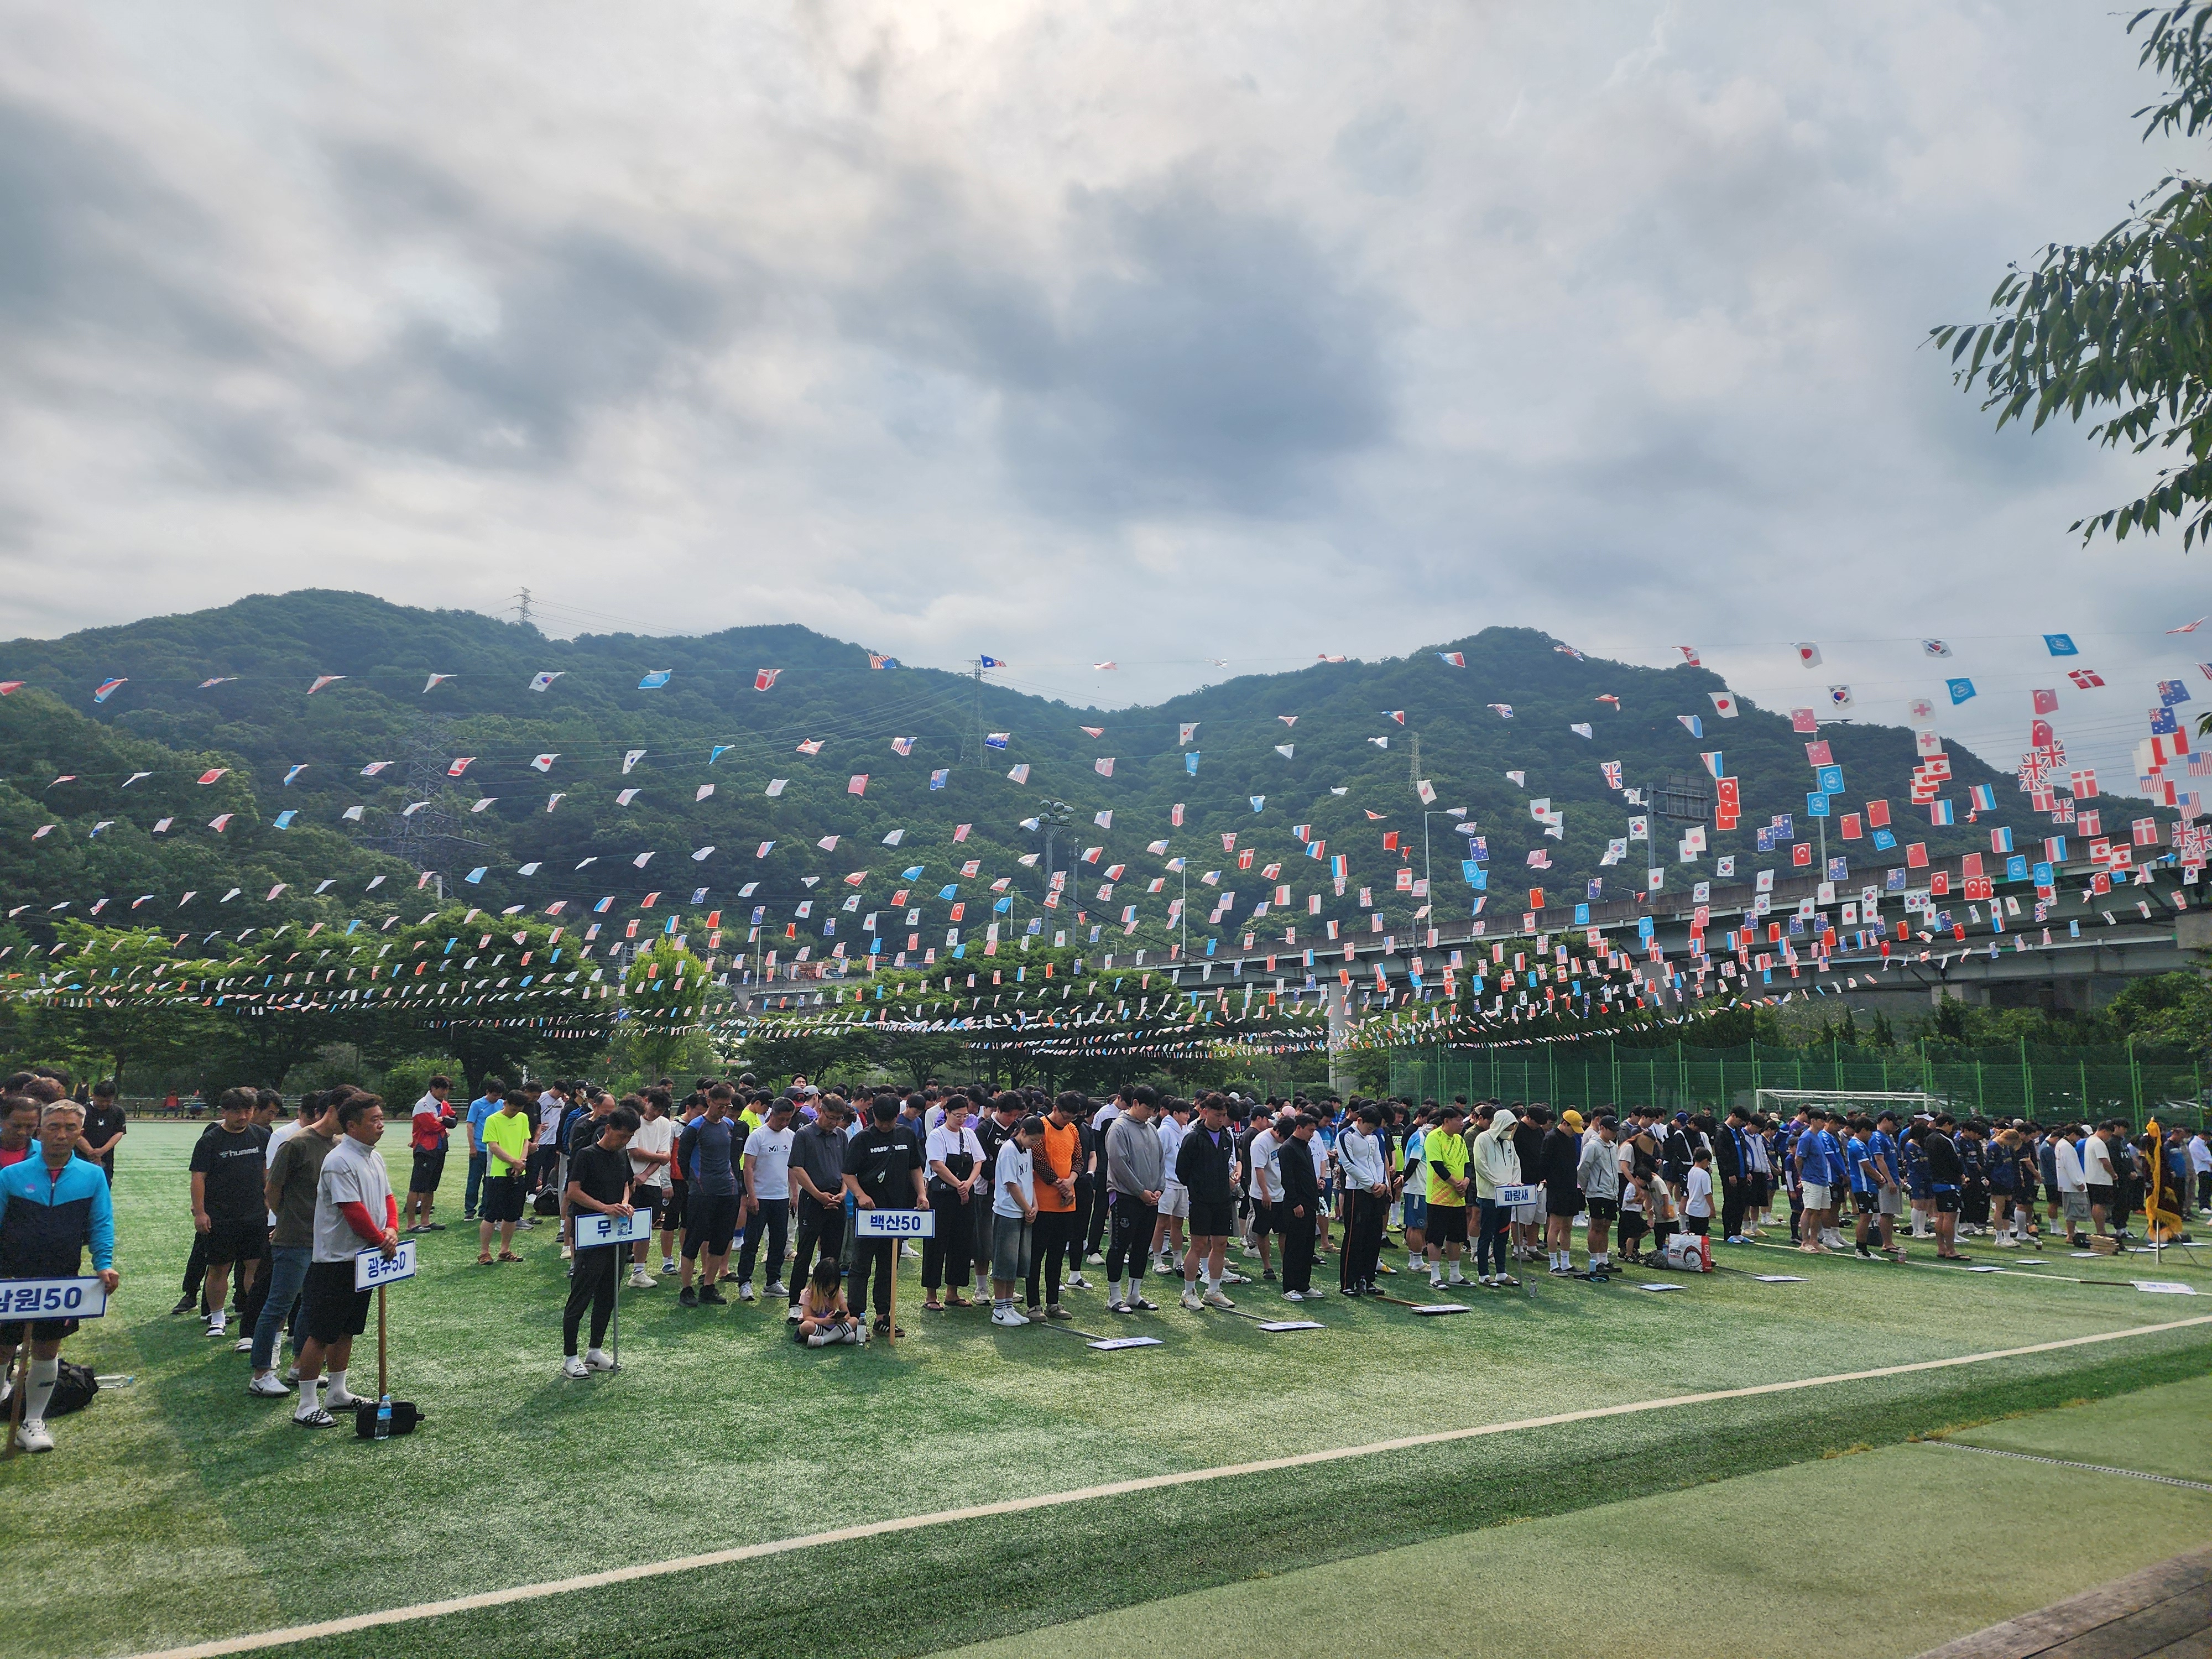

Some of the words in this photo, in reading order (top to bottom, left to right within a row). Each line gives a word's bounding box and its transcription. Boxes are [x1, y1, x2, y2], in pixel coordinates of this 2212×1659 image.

[229, 1146, 259, 1157] hummel
[1504, 1189, 1528, 1202] 파랑새
[597, 1217, 633, 1238] 무
[870, 1215, 921, 1230] 백산50
